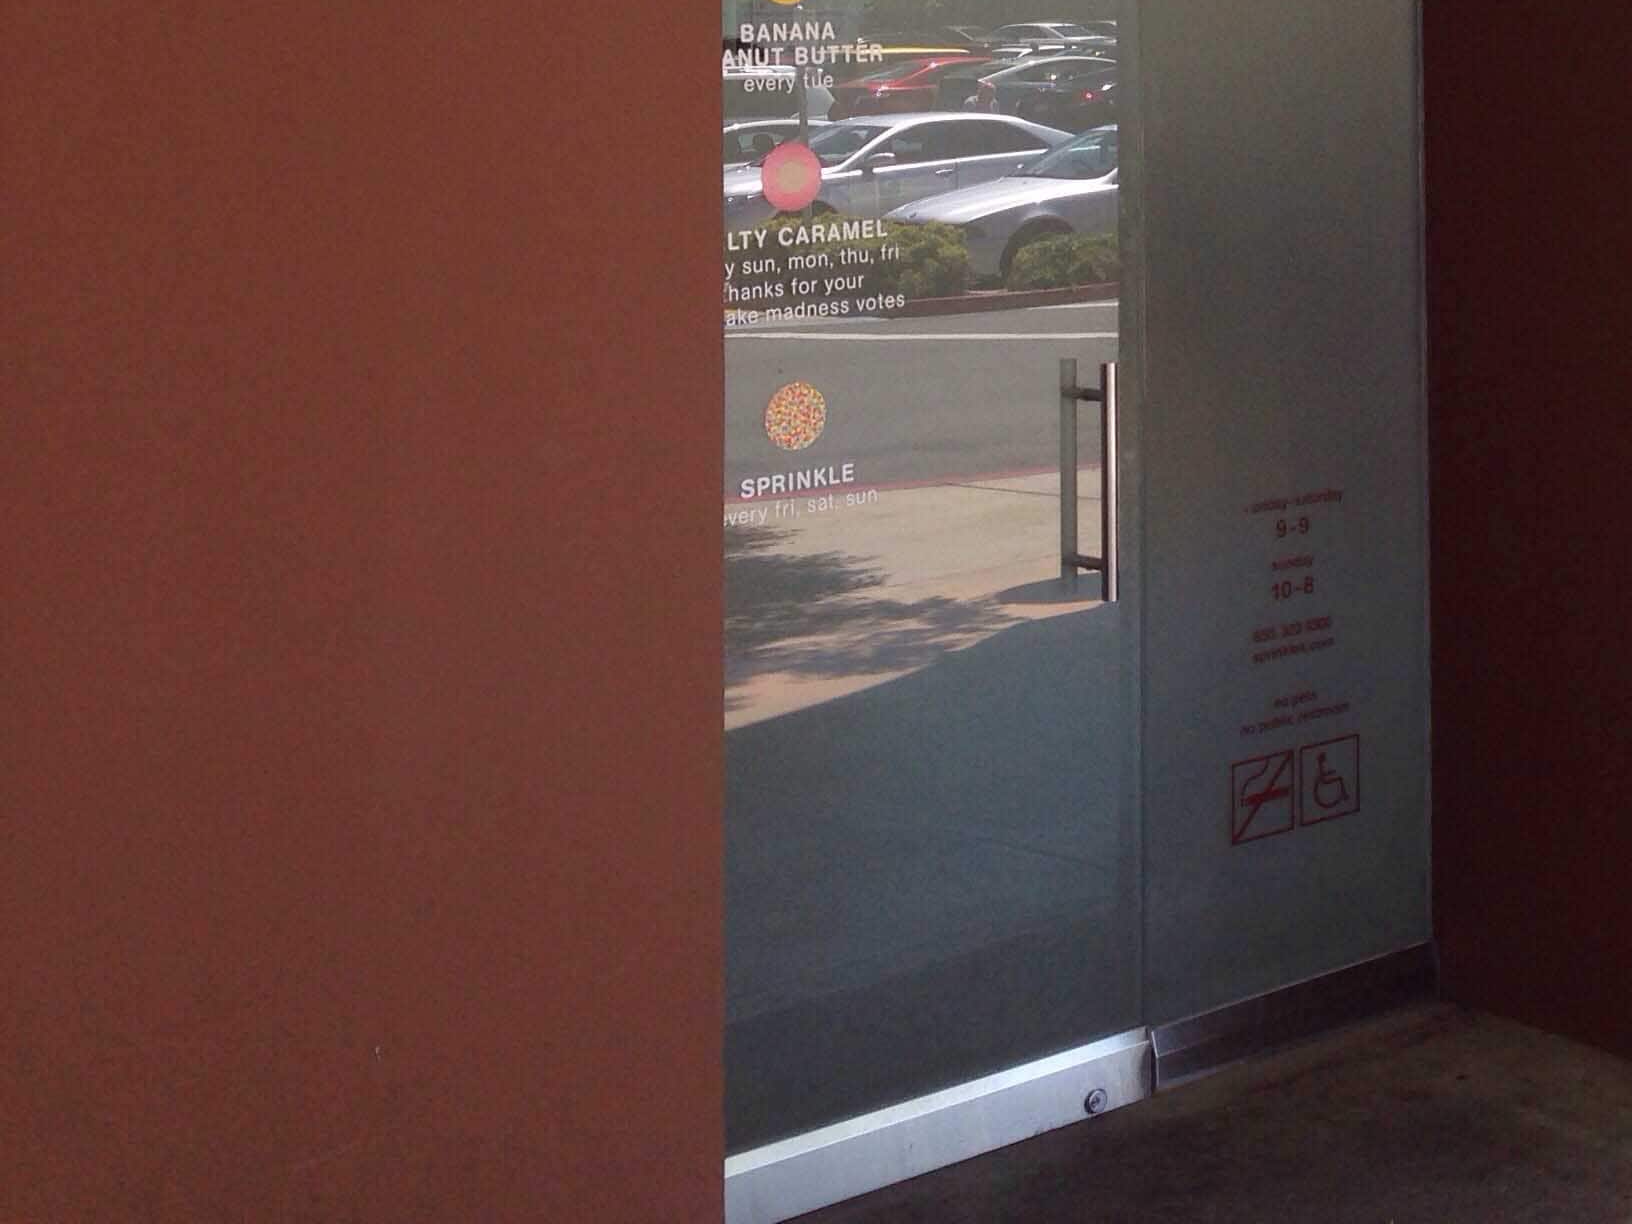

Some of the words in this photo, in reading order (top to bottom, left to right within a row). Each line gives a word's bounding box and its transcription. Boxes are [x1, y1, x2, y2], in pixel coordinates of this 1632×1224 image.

[740, 22, 836, 43] BANANA
[722, 47, 784, 67] ANUT
[795, 44, 884, 65] BUTTER
[743, 75, 796, 94] every
[804, 71, 834, 89] tue
[727, 229, 767, 251] LTY
[778, 219, 888, 246] CARAMEL
[742, 258, 781, 275] sun,
[788, 252, 834, 270] mon,
[840, 247, 875, 265] thu,
[791, 277, 818, 295] for
[824, 274, 865, 296] your
[725, 309, 759, 327] ake
[766, 299, 849, 322] madness
[856, 293, 905, 313] votes
[740, 463, 855, 499] SPRINKLE
[846, 488, 879, 507] sun
[1271, 575, 1315, 601] 10-8
